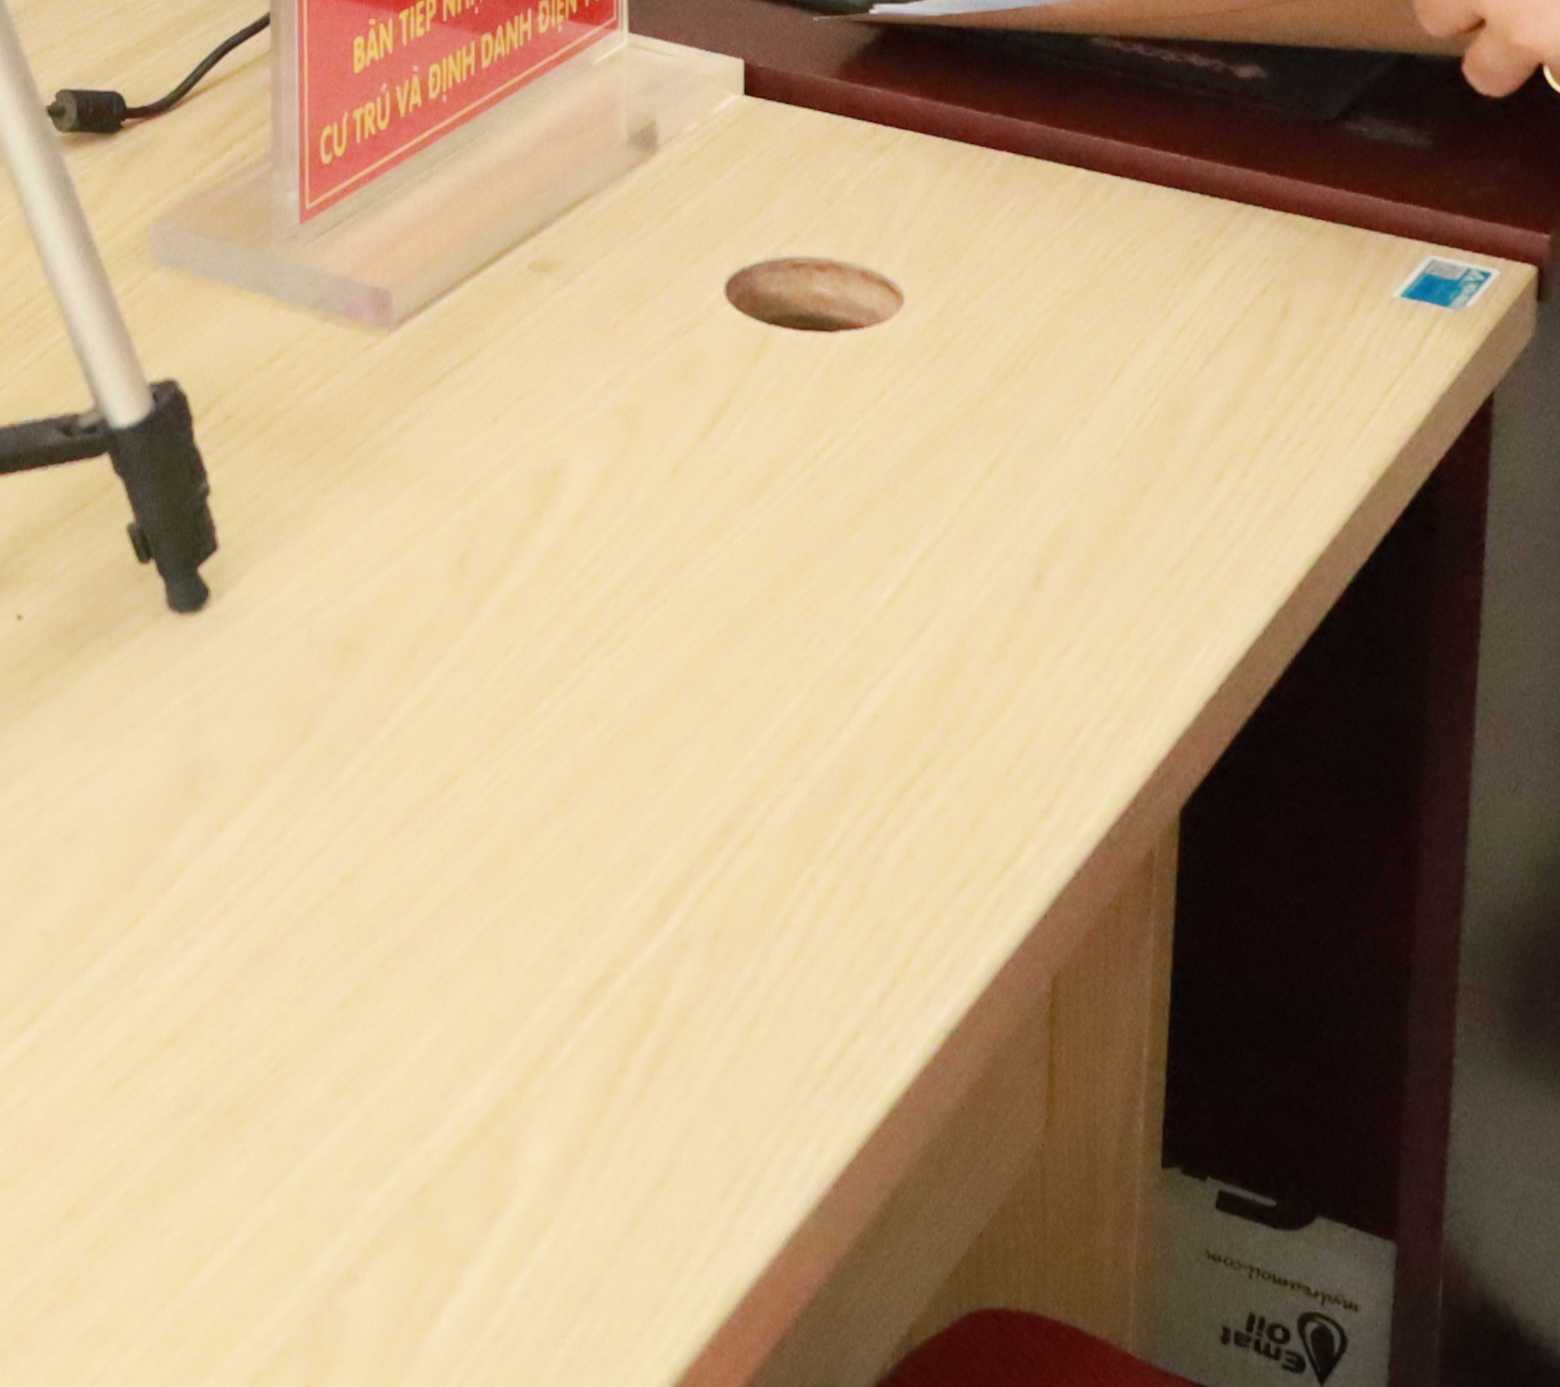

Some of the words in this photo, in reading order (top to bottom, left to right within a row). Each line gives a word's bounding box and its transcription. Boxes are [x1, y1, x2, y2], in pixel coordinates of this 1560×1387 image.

[319, 111, 348, 164] CƯ
[353, 83, 391, 144] TRÚ
[396, 65, 422, 117] VÀ
[428, 41, 476, 103] ĐỊNH
[481, 8, 532, 69] DANH
[1220, 1325, 1307, 1374] Emat
[1246, 1312, 1292, 1344] Oil
